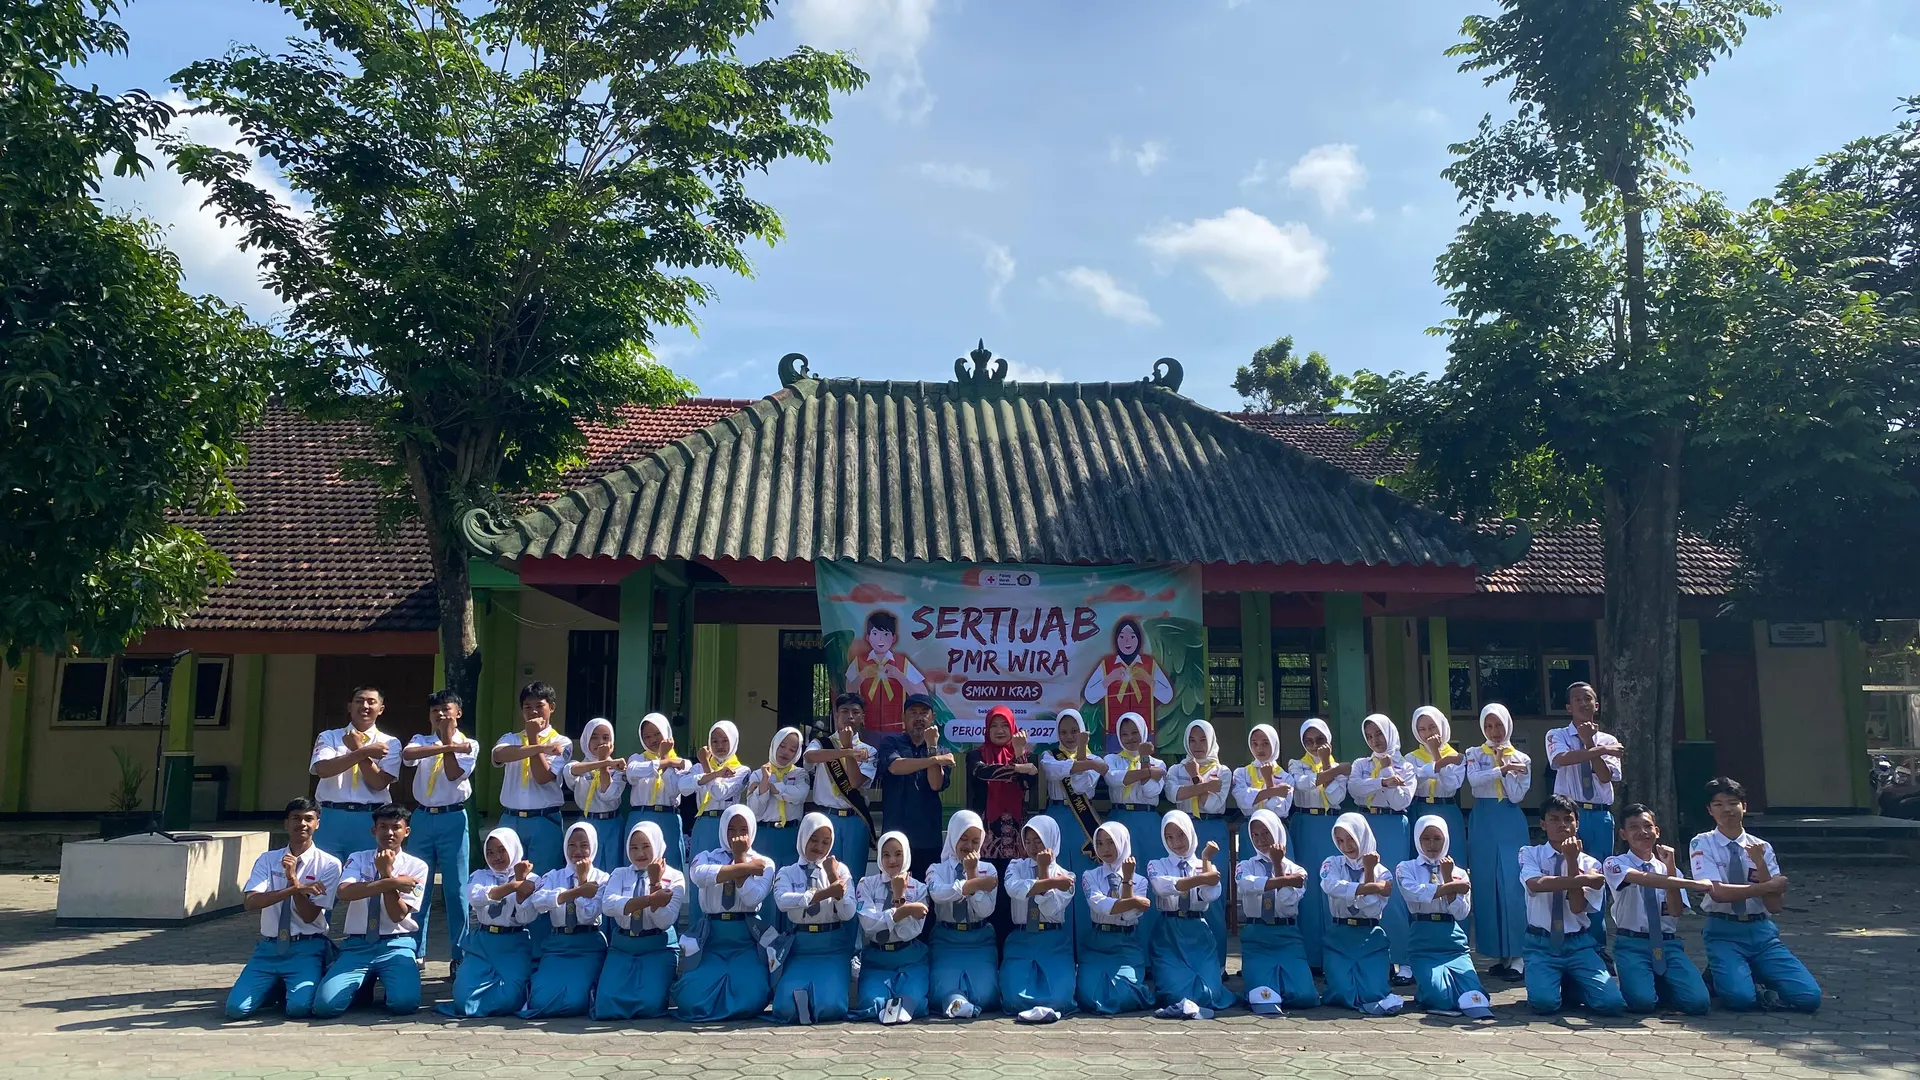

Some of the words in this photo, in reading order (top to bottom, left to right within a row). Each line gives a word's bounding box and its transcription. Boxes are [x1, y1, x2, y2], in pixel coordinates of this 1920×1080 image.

[911, 605, 1101, 646] SERTIJAB
[947, 647, 1001, 676] PMR
[1008, 648, 1070, 676] WIRA
[965, 685, 998, 698] SMKN
[1001, 686, 1006, 697] 1
[1008, 685, 1040, 699] KRAS
[952, 726, 986, 738] PERIOD
